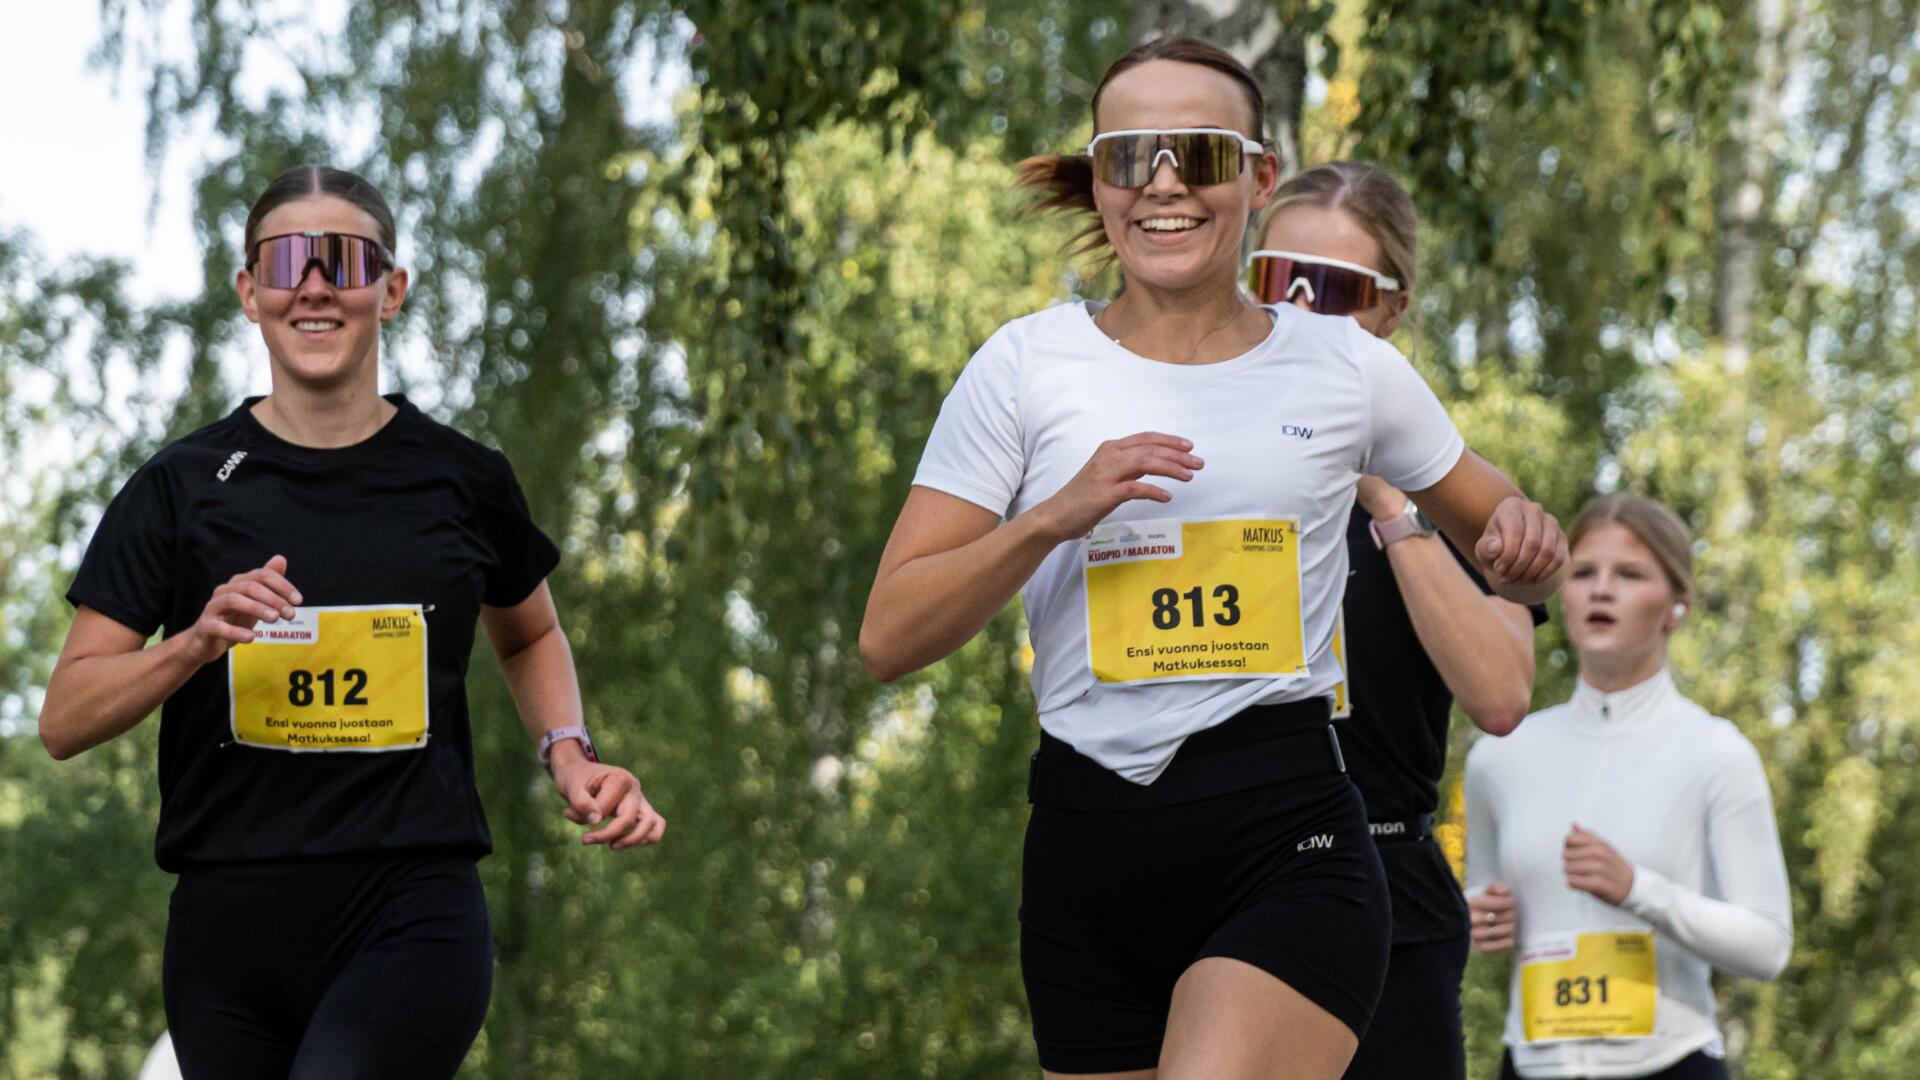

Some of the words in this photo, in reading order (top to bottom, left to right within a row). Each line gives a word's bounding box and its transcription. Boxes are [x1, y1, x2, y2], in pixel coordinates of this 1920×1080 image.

[1243, 527, 1284, 543] MATKUS
[1088, 549, 1121, 563] KUOPIO
[1128, 545, 1175, 557] MARATON
[1152, 584, 1241, 630] 813
[372, 616, 411, 630] MATKUS
[270, 631, 312, 639] MARATON
[1127, 645, 1154, 658] Ensi
[1158, 643, 1208, 655] vuonna
[1211, 640, 1269, 654] juostaan
[1153, 657, 1247, 672] Matkuksessa!
[288, 668, 368, 707] 812
[265, 717, 289, 728] Ensi
[292, 719, 337, 729] vuonna
[340, 717, 393, 730] juostaan
[287, 731, 371, 744] Matkuksessa!
[1555, 975, 1609, 1006] 831
